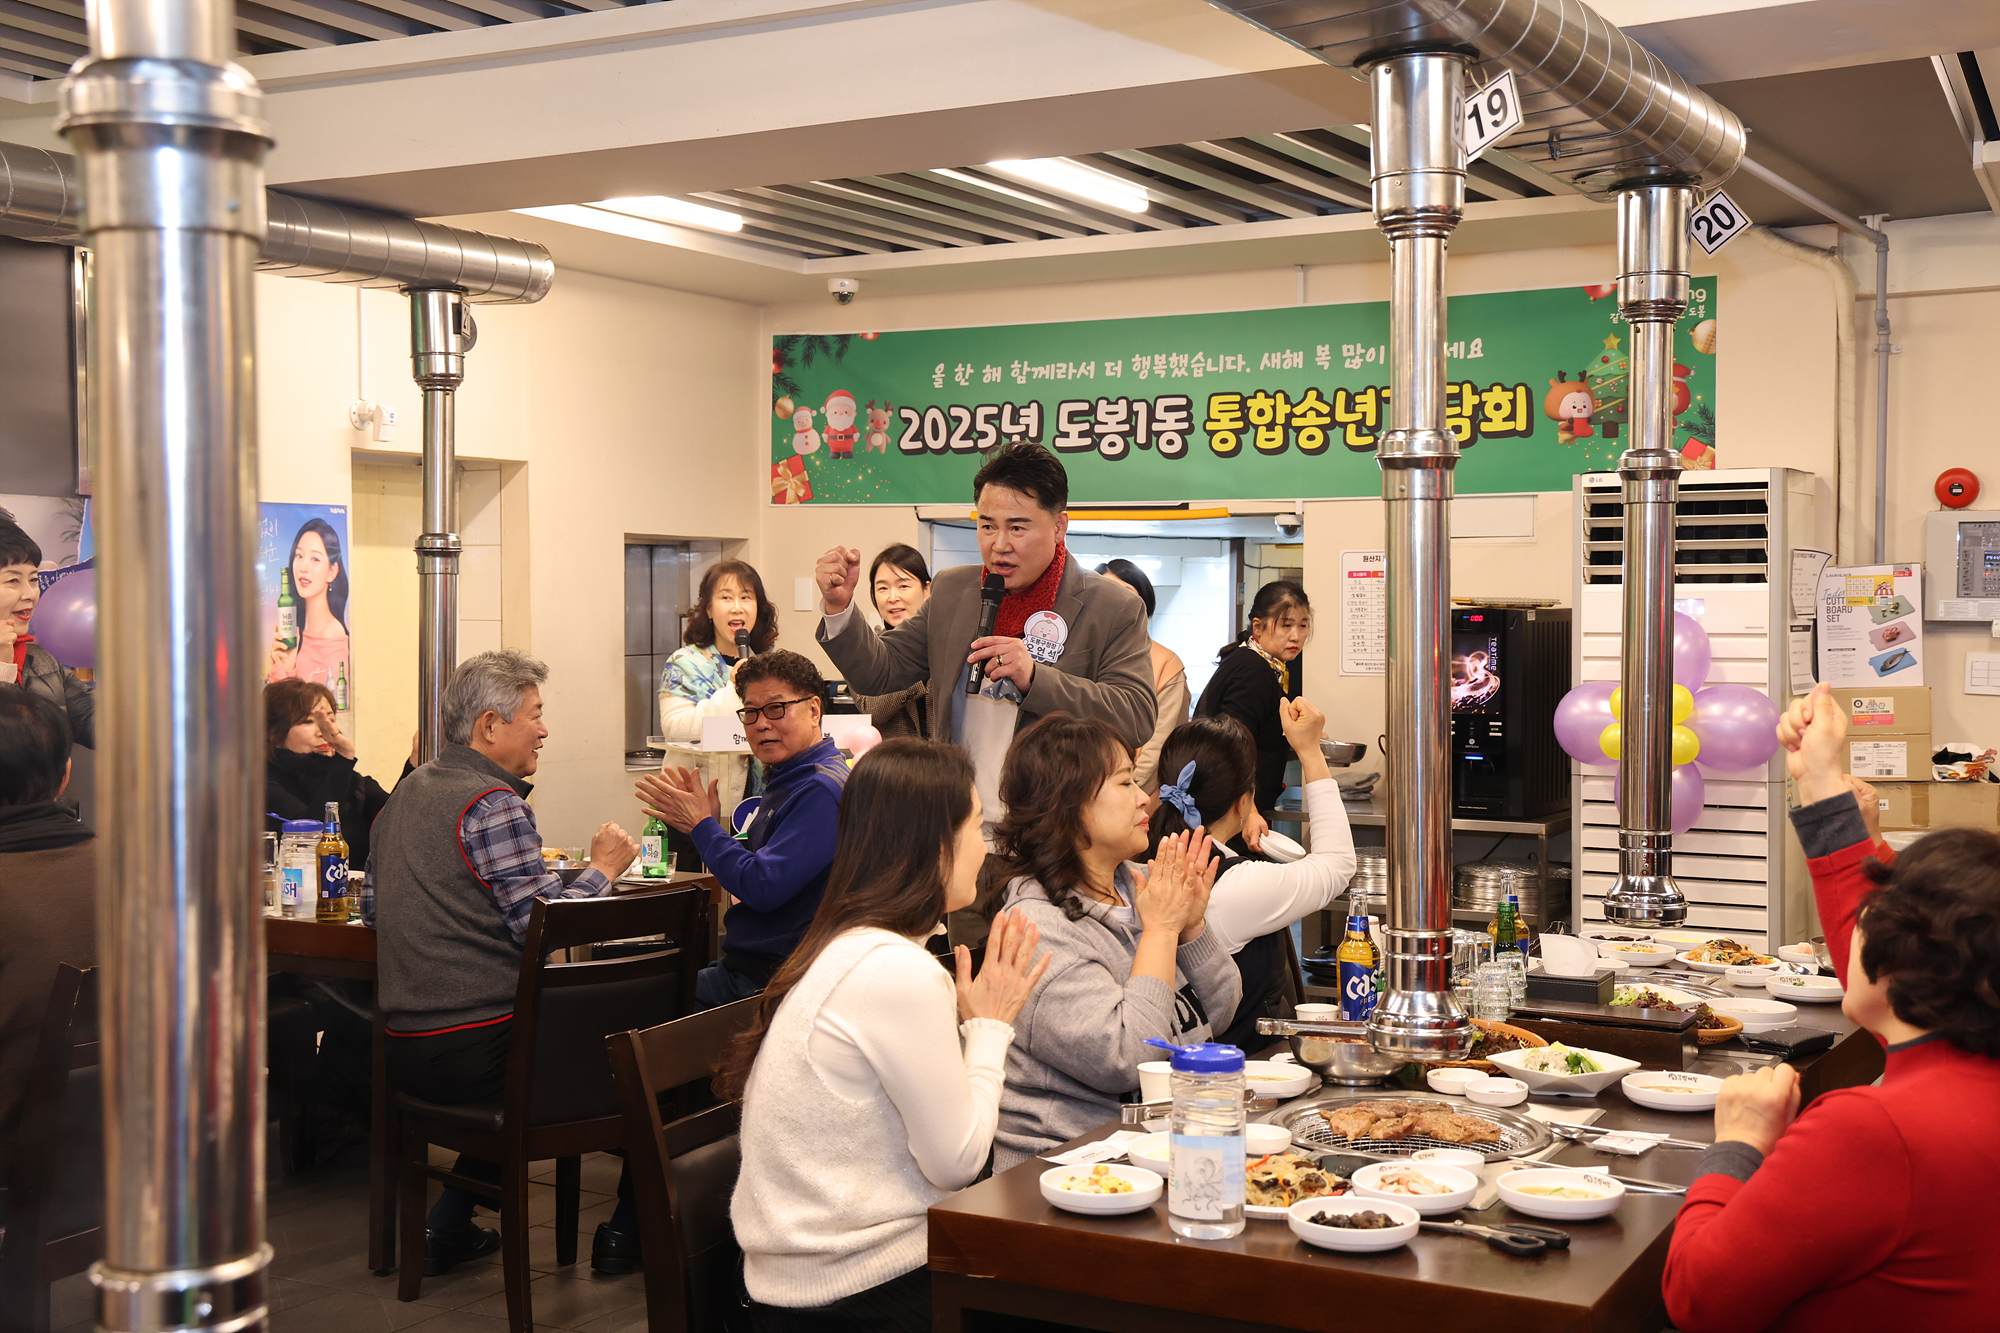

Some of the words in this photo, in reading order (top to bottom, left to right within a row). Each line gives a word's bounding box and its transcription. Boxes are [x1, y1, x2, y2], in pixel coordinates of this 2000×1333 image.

[1467, 87, 1509, 140] 19
[1694, 202, 1736, 246] 20
[1688, 304, 1706, 319] 도봉
[932, 363, 945, 388] 올
[954, 363, 974, 386] 한
[982, 364, 1002, 383] 해
[1010, 359, 1095, 385] 함께라서
[1104, 359, 1123, 378] 더
[1131, 351, 1251, 380] 행복했습니다.
[1260, 348, 1304, 371] 새해
[1315, 344, 1332, 370] 복
[1341, 343, 1386, 370] 많이
[898, 399, 1043, 455] 2025년
[1052, 395, 1195, 462] 도봉1동
[1203, 379, 1534, 460] 통합송년담회
[1363, 555, 1381, 563] 원산지
[1826, 597, 1846, 606] CUTT
[1826, 605, 1853, 614] BOARD
[1826, 614, 1840, 623] SET
[1359, 994, 1376, 1006] FRES
